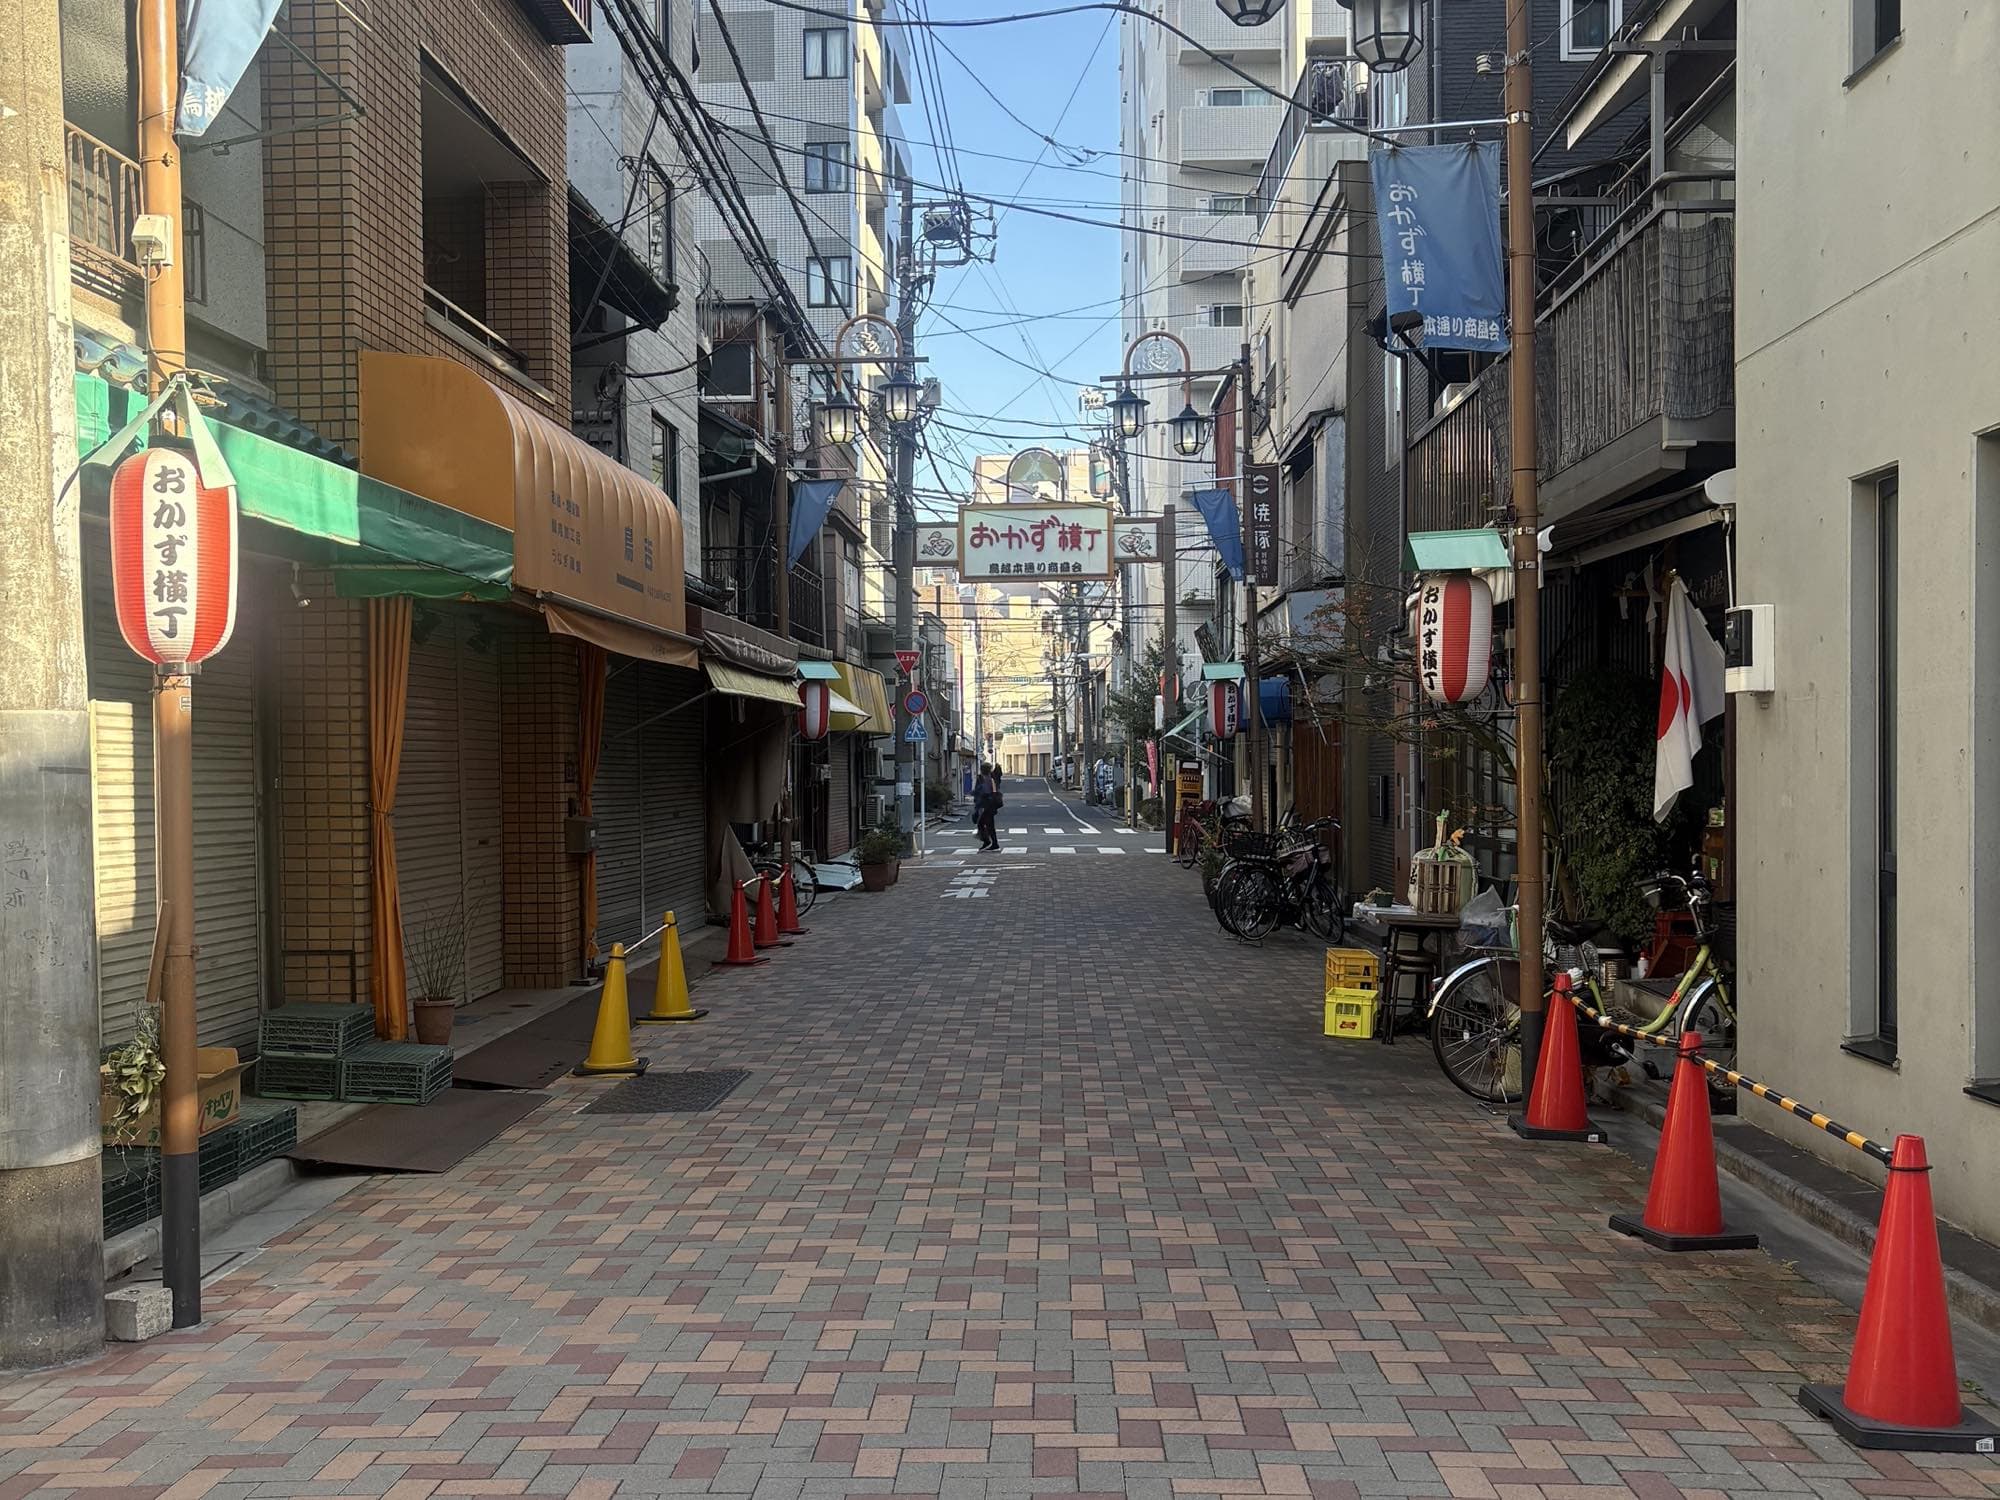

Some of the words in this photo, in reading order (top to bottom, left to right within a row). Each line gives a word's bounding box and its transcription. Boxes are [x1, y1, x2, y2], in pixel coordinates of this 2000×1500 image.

[1387, 180, 1427, 306] おかず横丁
[153, 466, 188, 638] おかず横丁
[970, 514, 1102, 553] おかず横丁
[1423, 586, 1439, 691] おかず横丁
[1227, 685, 1236, 733] おかず横丁
